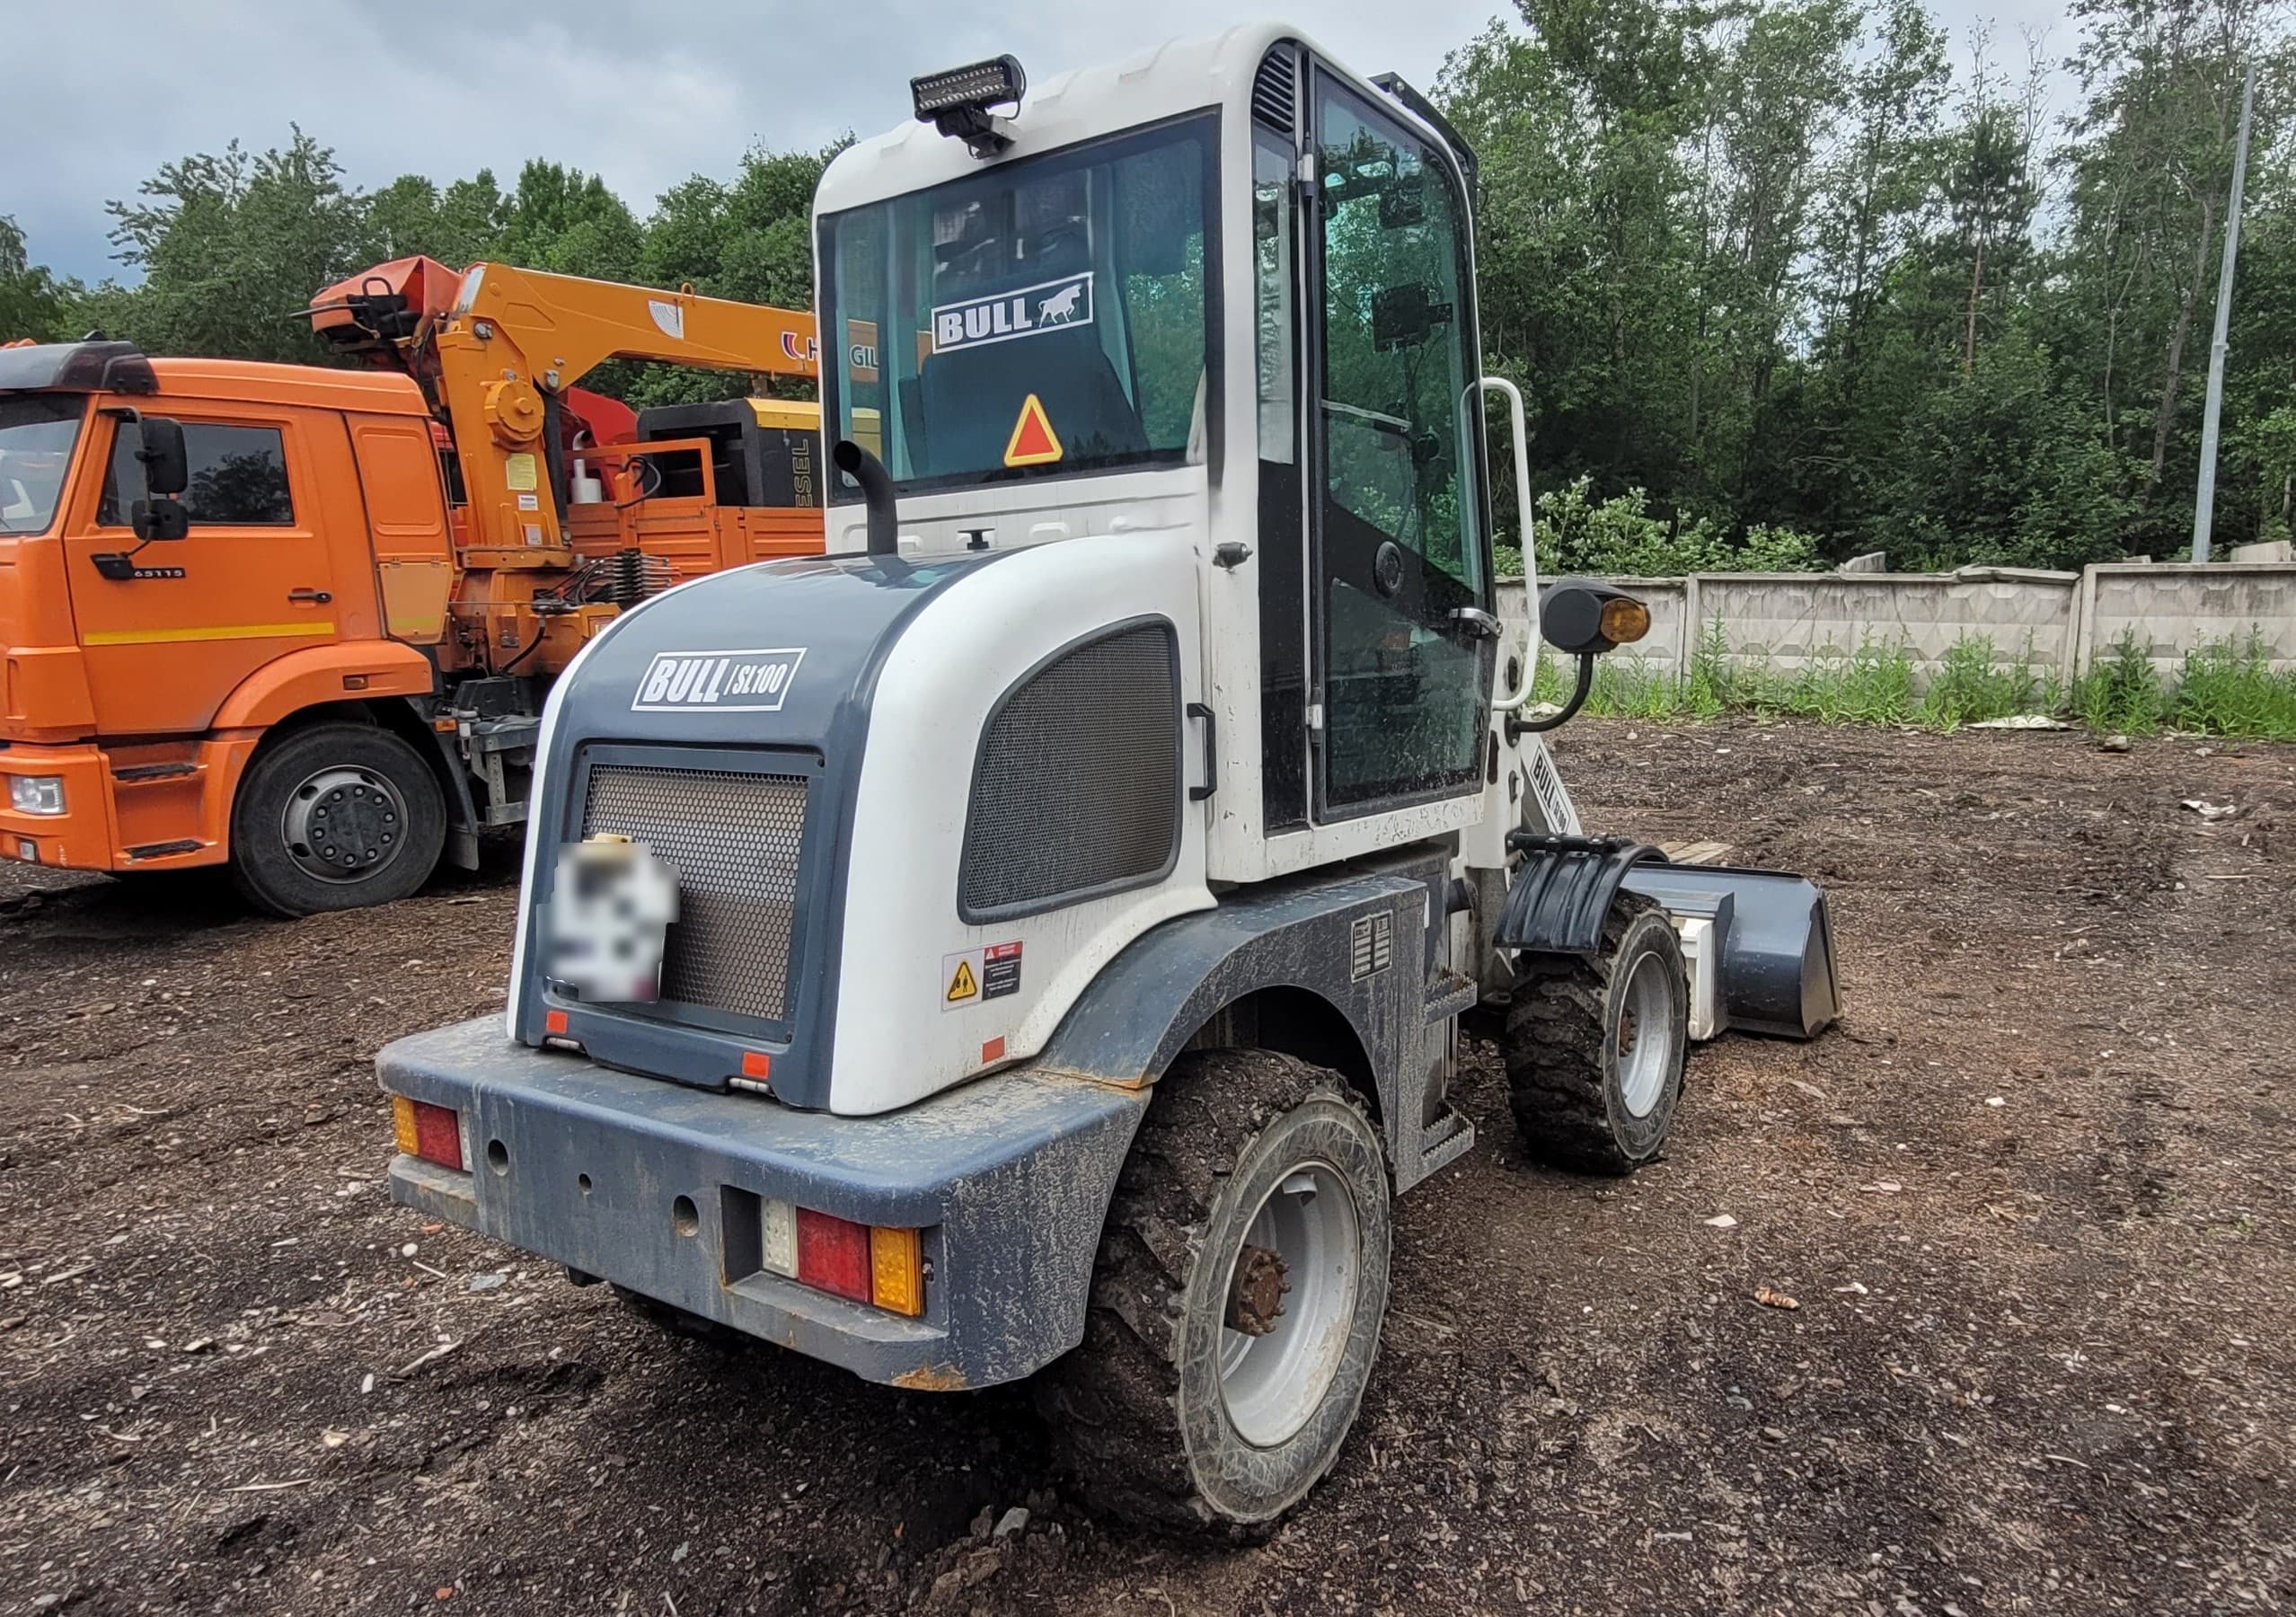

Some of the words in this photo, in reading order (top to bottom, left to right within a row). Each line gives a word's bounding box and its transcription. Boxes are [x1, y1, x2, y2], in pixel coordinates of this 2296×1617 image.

[939, 297, 1032, 345] BULL
[135, 570, 182, 578] 65115
[642, 658, 730, 703] BULL
[1533, 754, 1555, 809] BULL
